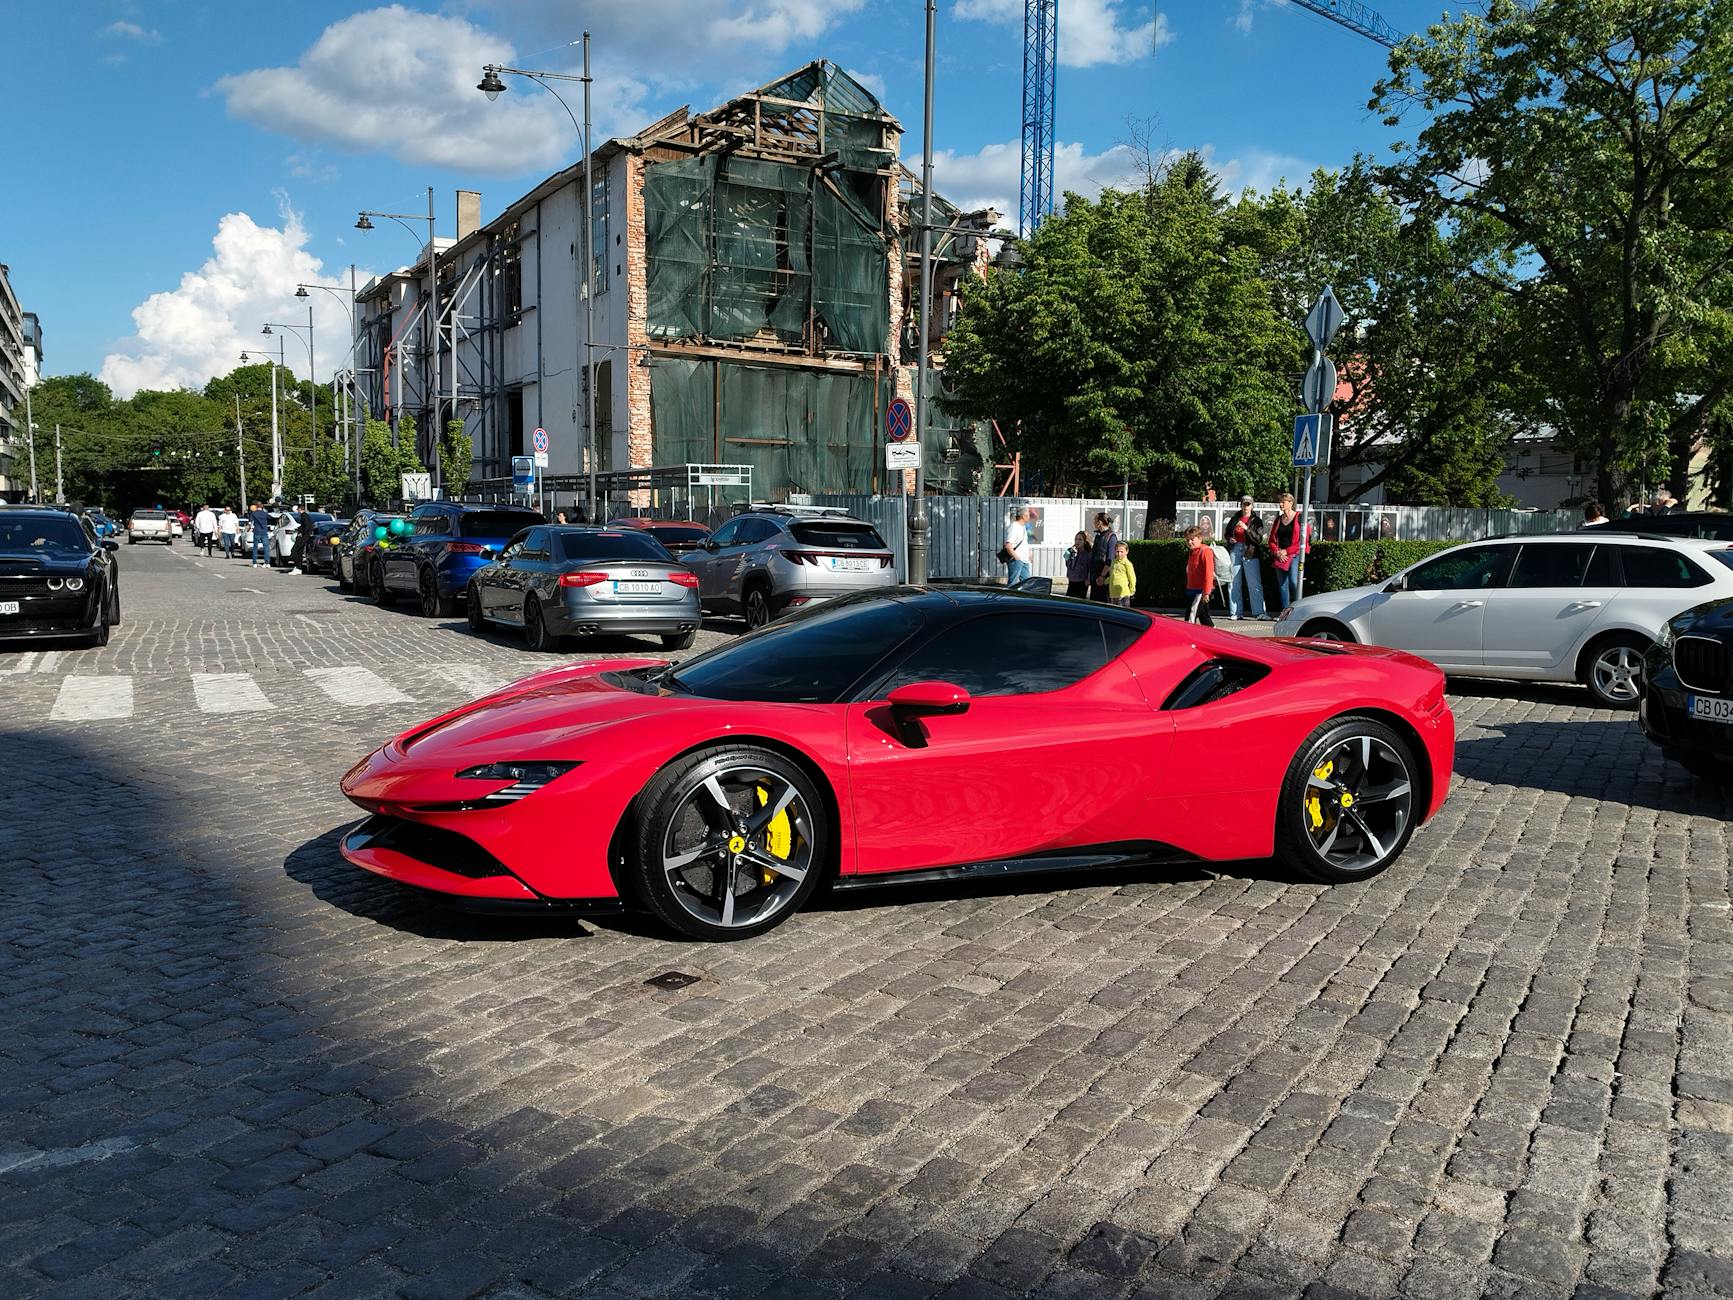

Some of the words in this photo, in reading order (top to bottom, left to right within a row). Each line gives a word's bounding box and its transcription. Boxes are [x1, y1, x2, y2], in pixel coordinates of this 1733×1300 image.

[619, 583, 630, 592] CB
[631, 583, 649, 592] 1010
[4, 603, 17, 611] OB
[1696, 698, 1711, 715] CB
